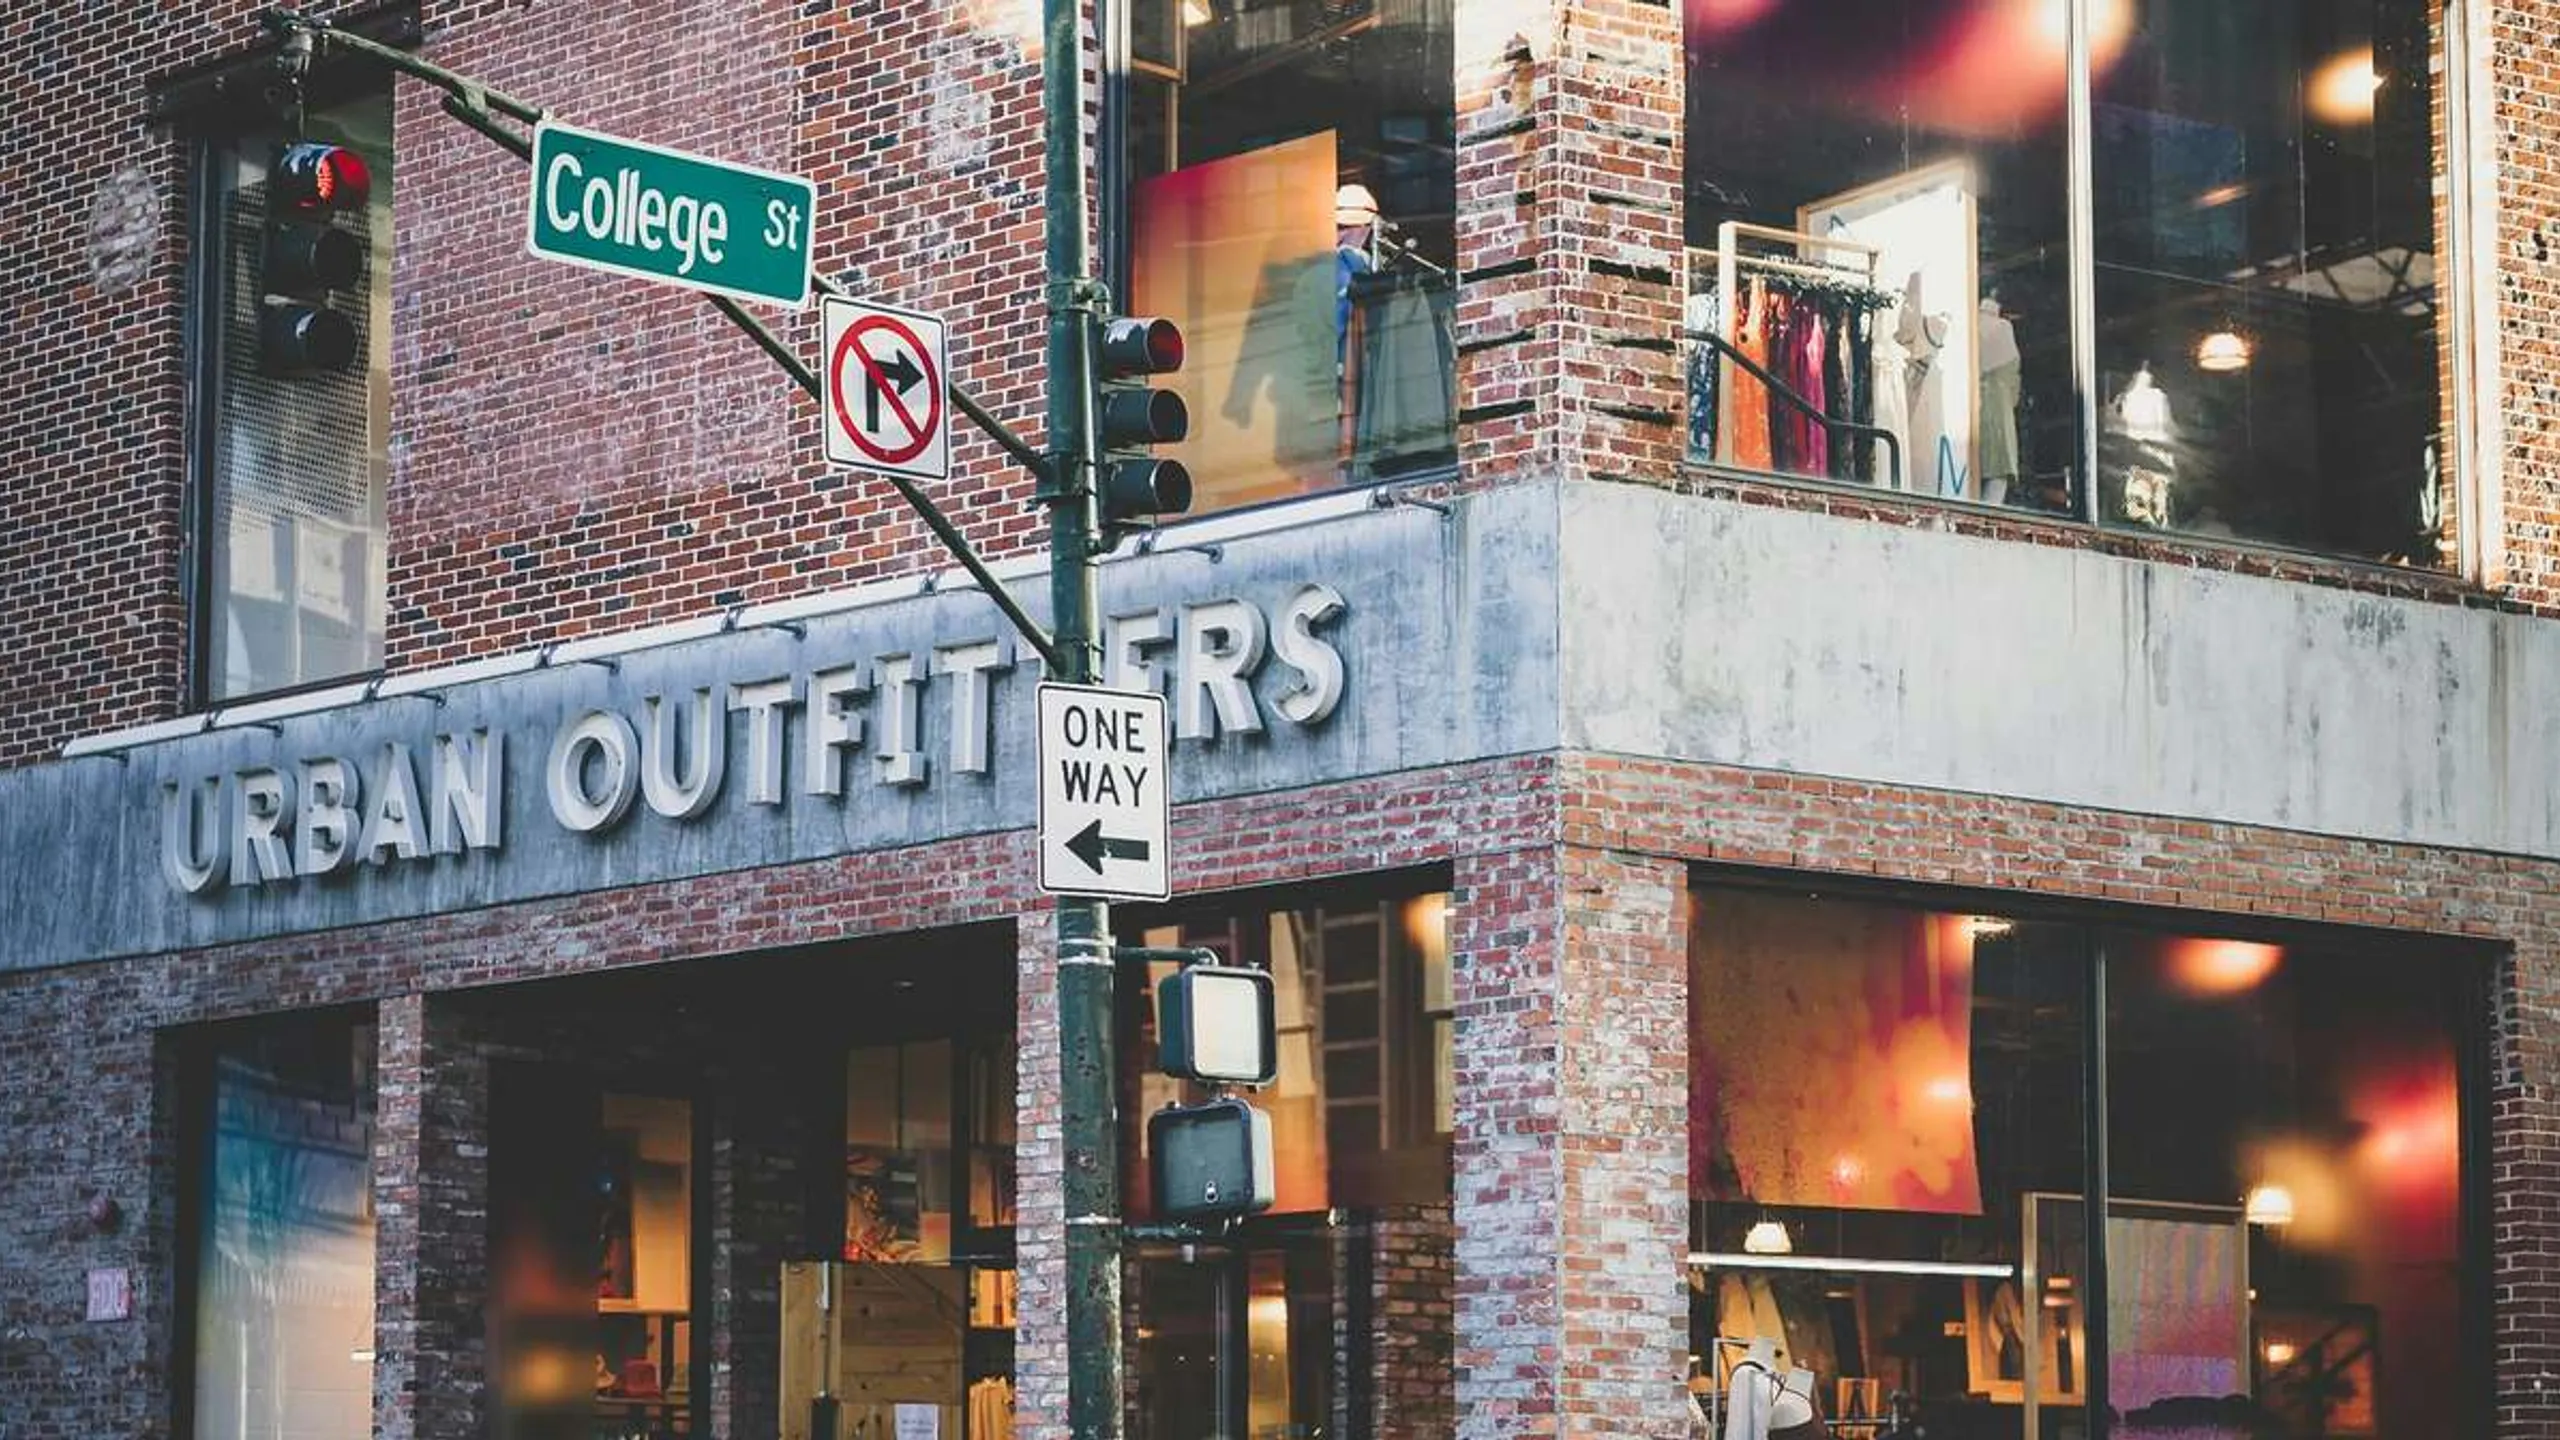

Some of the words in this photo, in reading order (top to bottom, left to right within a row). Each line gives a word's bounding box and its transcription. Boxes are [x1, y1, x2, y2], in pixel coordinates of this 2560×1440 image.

[546, 153, 728, 275] College
[763, 199, 801, 250] St
[161, 726, 503, 892] URBAN
[547, 582, 1346, 831] OUTFITERS
[1063, 705, 1145, 753] ONE
[1061, 759, 1148, 807] WAY
